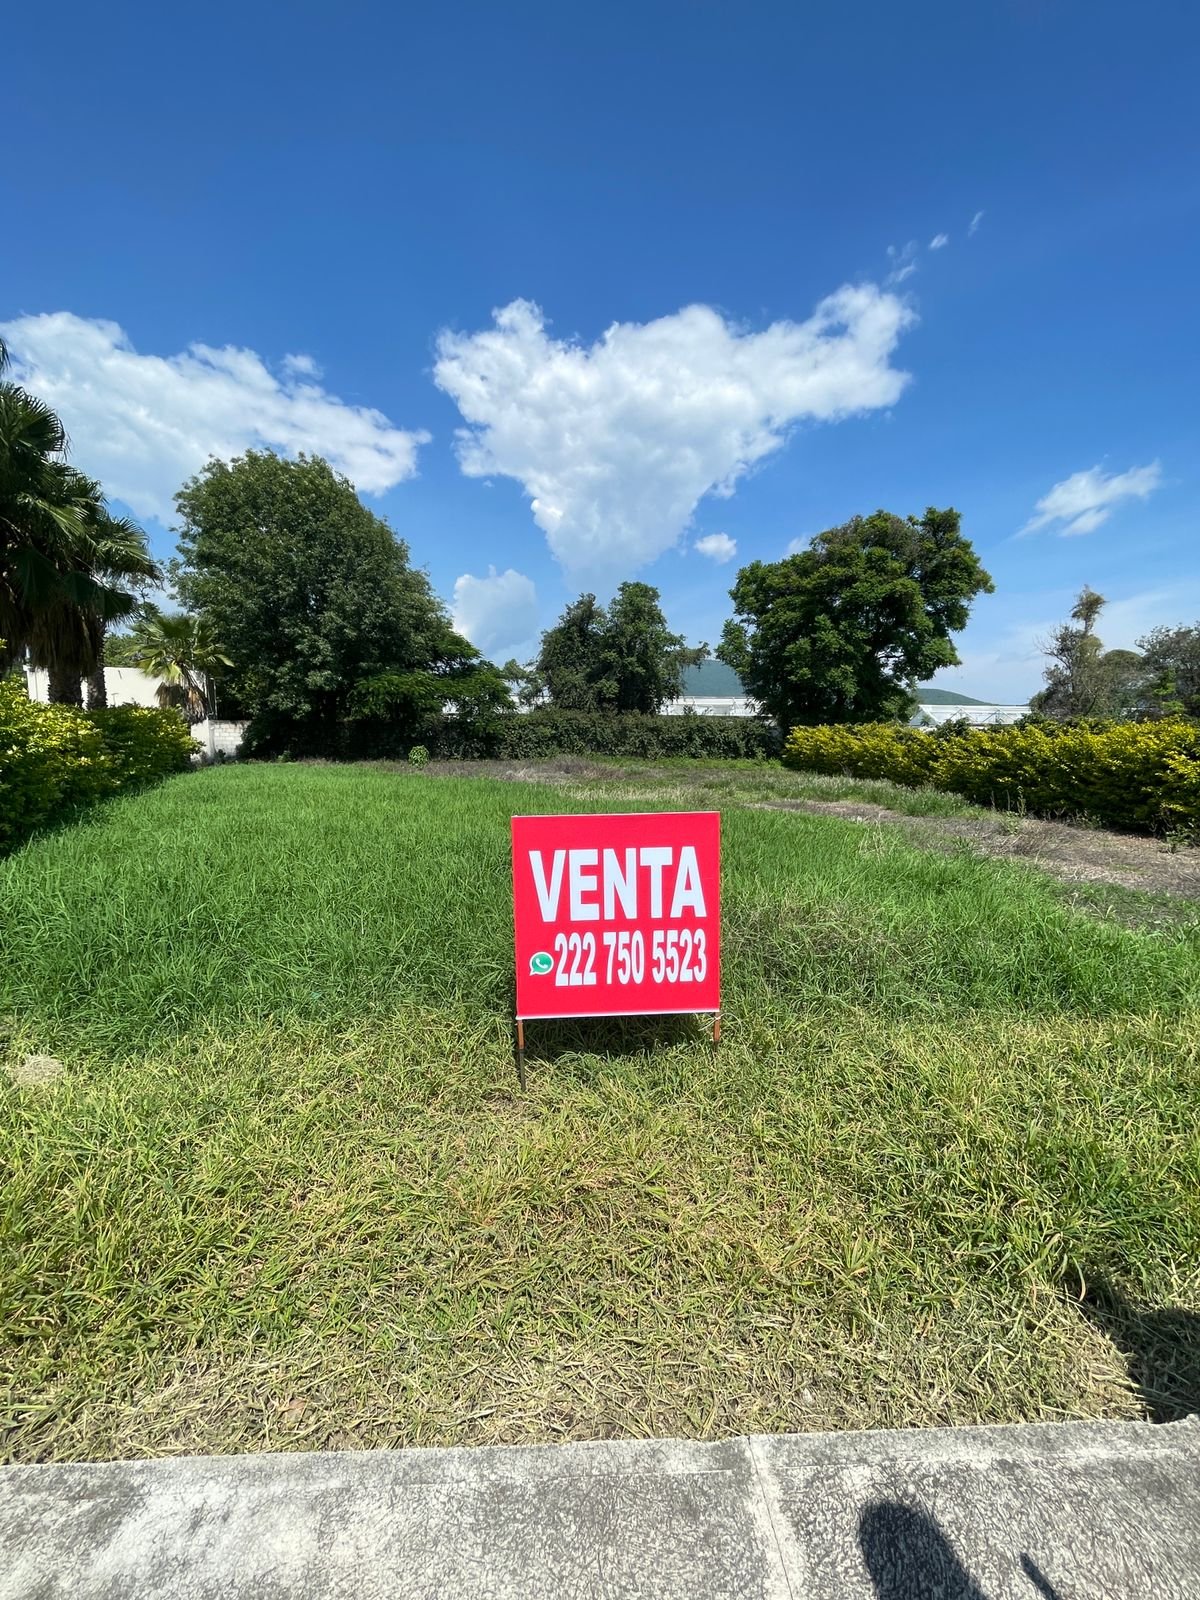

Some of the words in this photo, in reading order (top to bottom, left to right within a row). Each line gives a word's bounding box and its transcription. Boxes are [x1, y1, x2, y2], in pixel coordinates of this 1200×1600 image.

[528, 846, 707, 922] VENTA
[555, 932, 597, 987] 222
[603, 930, 645, 985] 750
[652, 928, 707, 983] 5523
